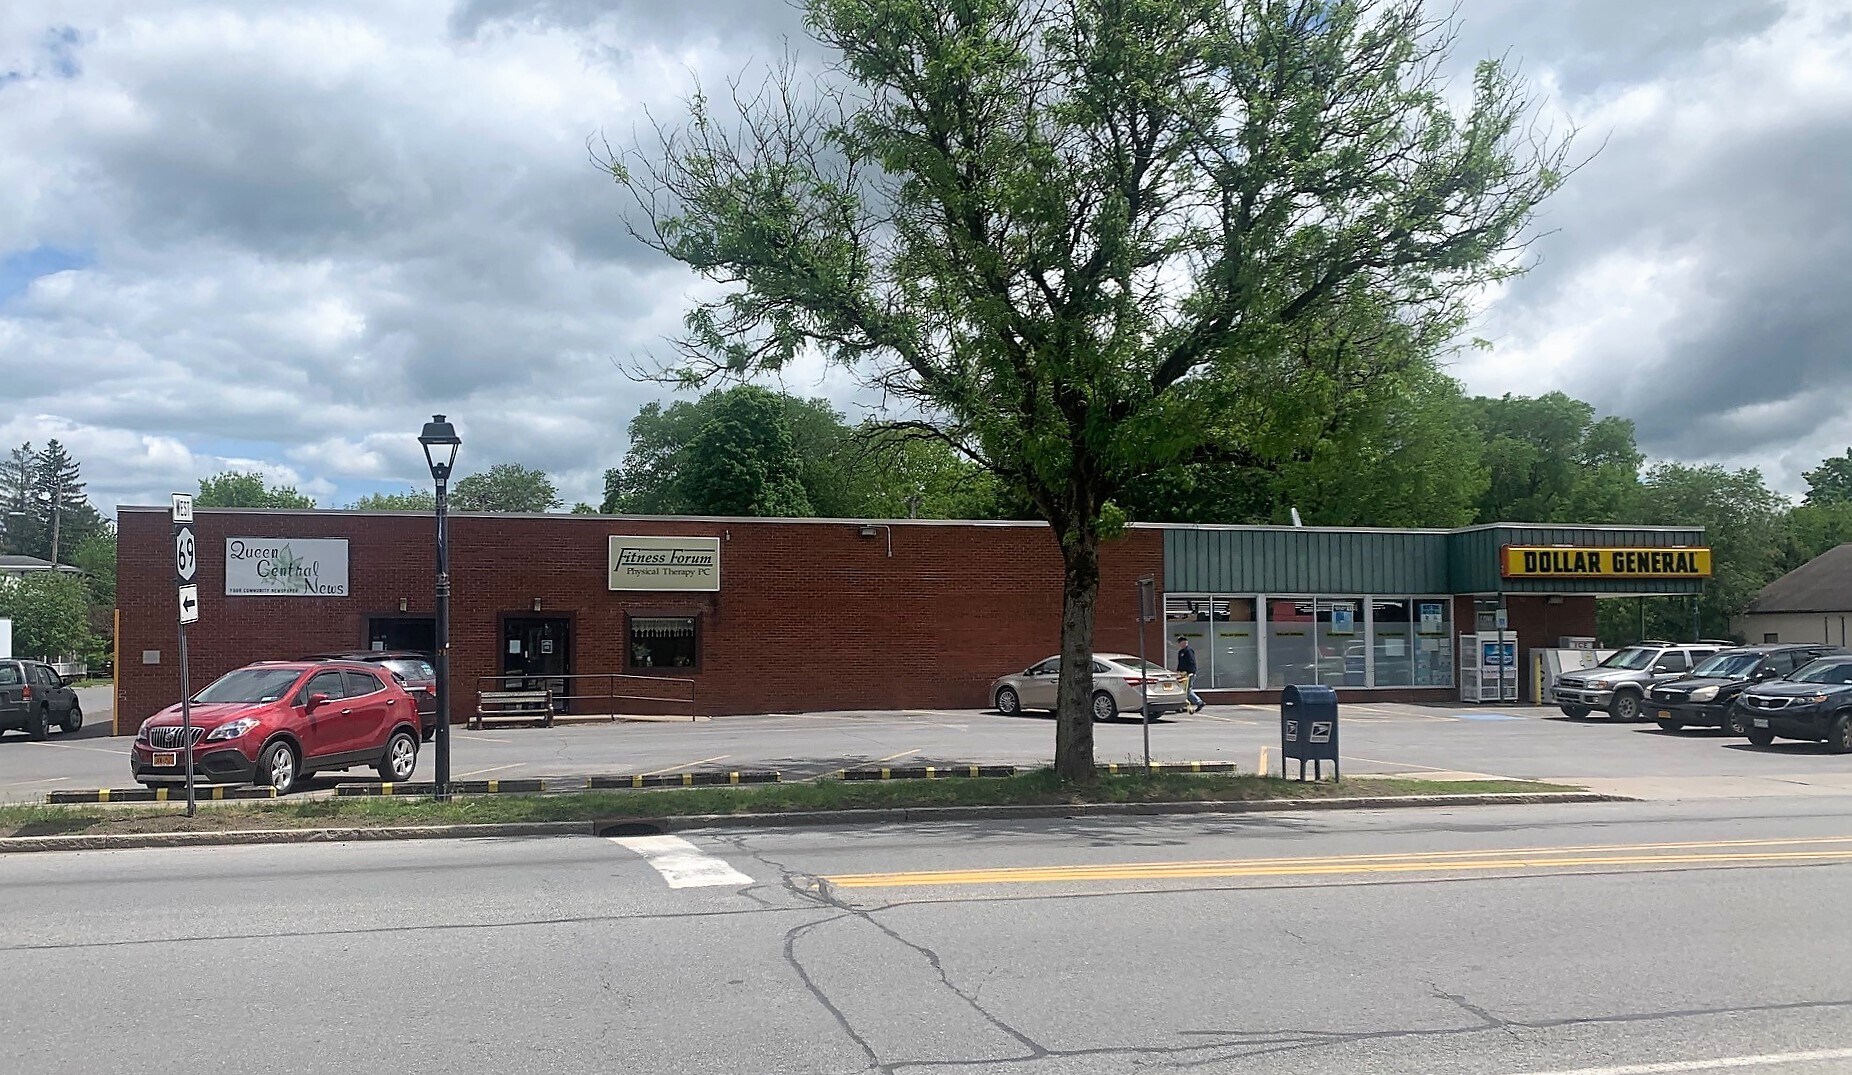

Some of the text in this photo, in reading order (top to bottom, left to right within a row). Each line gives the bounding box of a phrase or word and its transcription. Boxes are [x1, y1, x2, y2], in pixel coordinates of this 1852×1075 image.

[175, 498, 190, 517] WEST
[178, 537, 194, 571] 69
[230, 540, 278, 560] Queen
[614, 547, 712, 571] Fitness Forum
[256, 559, 320, 578] Central
[1524, 551, 1699, 573] DOLLAR GENERAL
[626, 567, 711, 577] Physical Therapy PC
[304, 577, 344, 594] News
